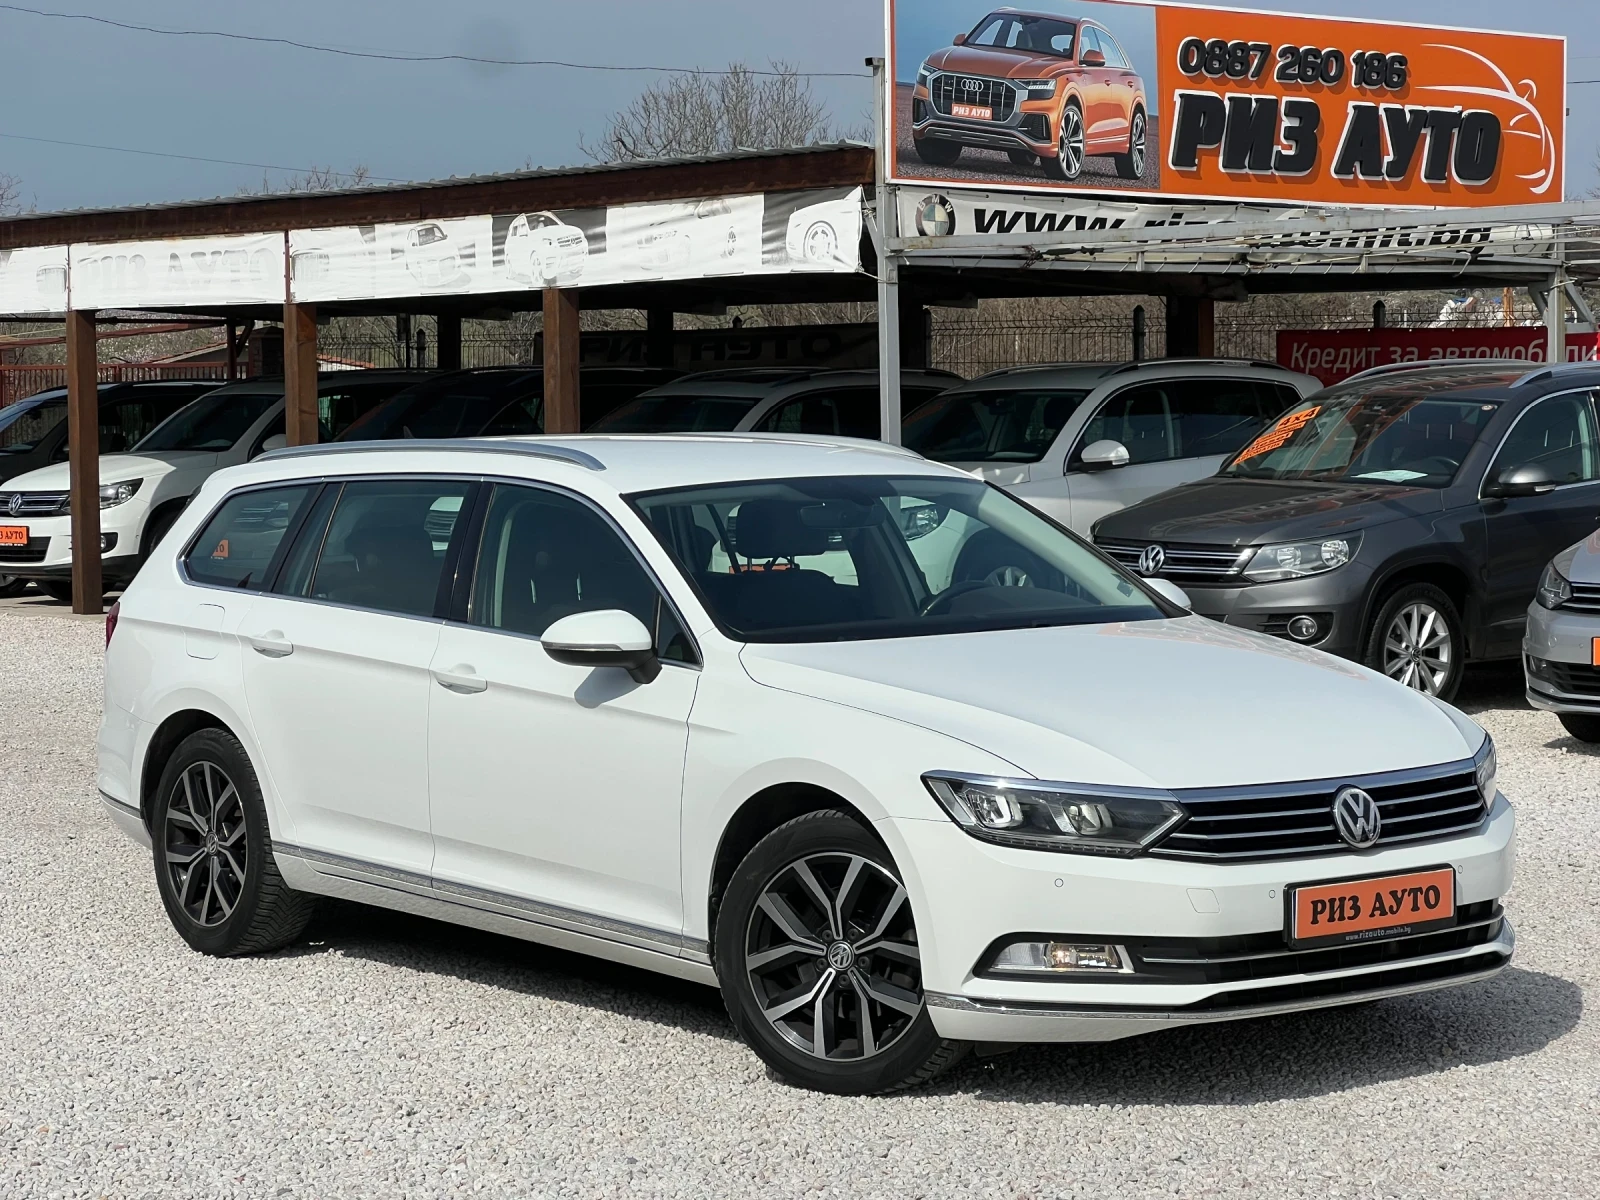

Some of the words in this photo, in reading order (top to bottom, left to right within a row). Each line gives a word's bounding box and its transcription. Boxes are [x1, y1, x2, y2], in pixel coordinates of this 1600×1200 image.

[1177, 36, 1272, 80] 0887
[1275, 44, 1345, 86] 260
[1351, 49, 1408, 89] 186
[953, 106, 970, 116] РИЗ
[971, 108, 991, 118] АУТО
[1168, 89, 1320, 175] РИЗ
[1331, 101, 1501, 185] АУТО
[1291, 342, 1381, 374] Кредит
[1390, 346, 1419, 362] за
[5, 531, 23, 540] АУТО
[1310, 895, 1361, 925] РИЗ
[1369, 885, 1441, 918] АУТО
[1345, 926, 1412, 941] www.rizauto.mobile.bg
